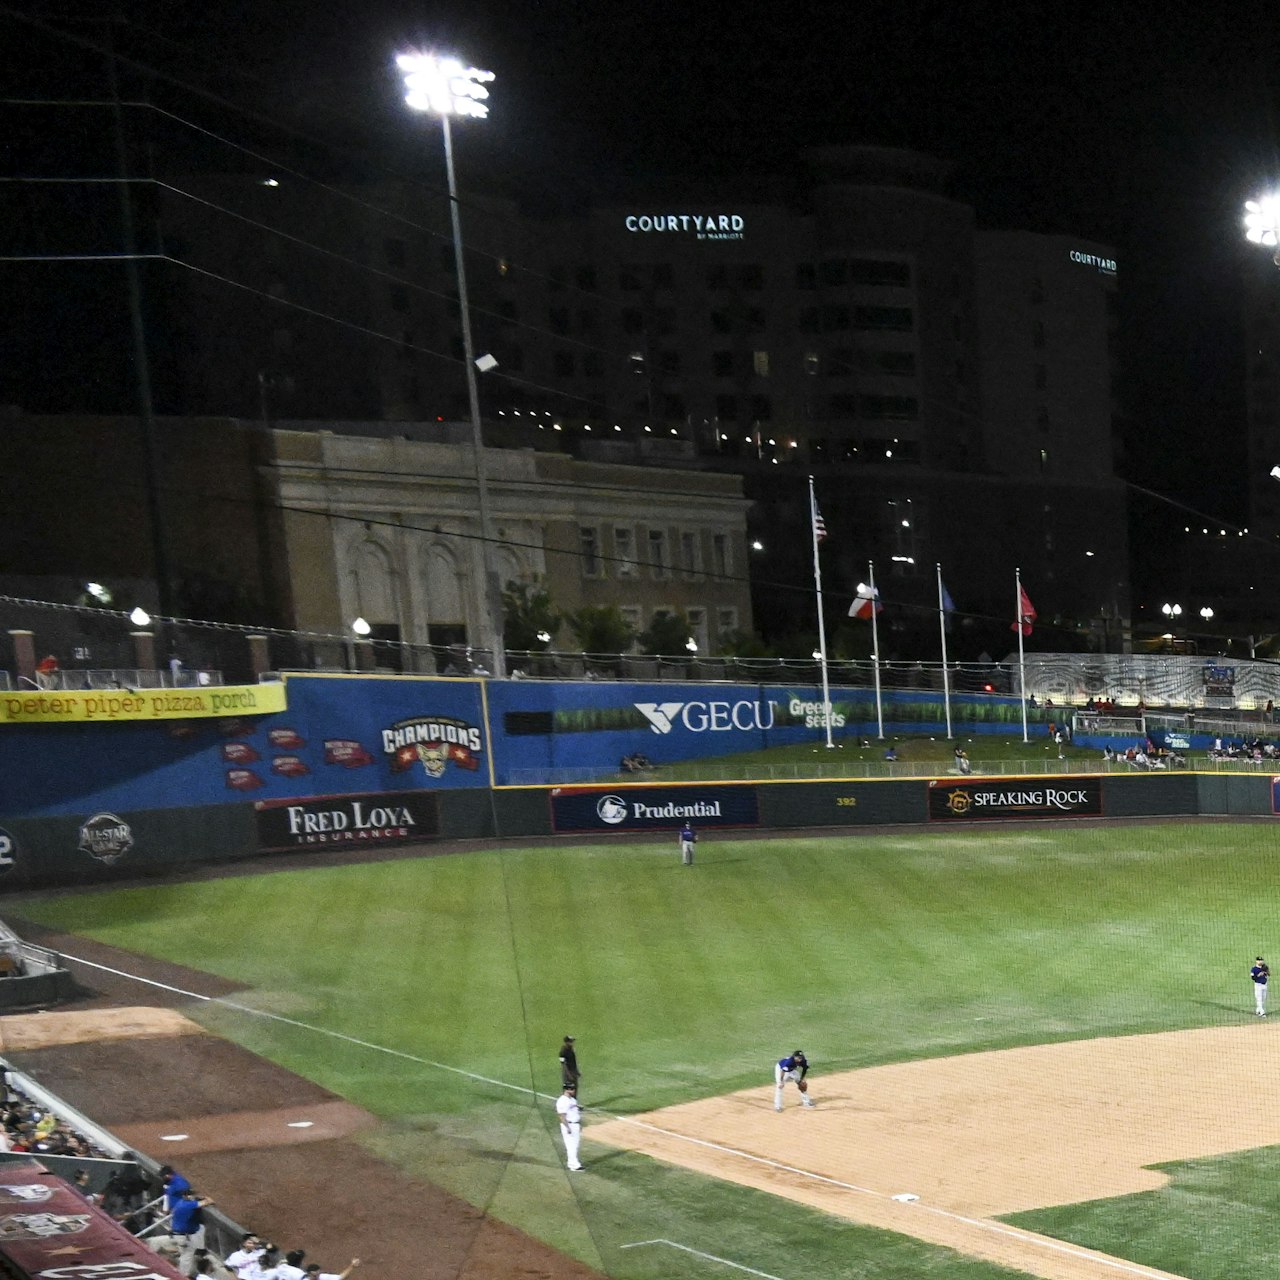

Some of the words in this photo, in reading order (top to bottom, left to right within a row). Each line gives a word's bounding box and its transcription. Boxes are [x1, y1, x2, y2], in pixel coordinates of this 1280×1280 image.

[625, 215, 744, 232] COURTYARD
[1069, 250, 1117, 271] COURTYARD
[5, 694, 77, 719] peter
[84, 694, 145, 718] piper
[150, 694, 206, 717] pizza
[209, 689, 257, 713] porch
[789, 698, 833, 716] Green
[682, 700, 775, 732] GECU
[804, 711, 846, 728] seats
[382, 722, 481, 754] CHAMPIONS
[836, 797, 856, 806] 392
[974, 790, 1043, 807] SPEAKING
[1045, 788, 1088, 810] ROCK
[287, 805, 347, 834] FRED
[352, 802, 416, 830] LOYA
[633, 800, 722, 819] Prudential
[297, 828, 410, 843] INSURANCE
